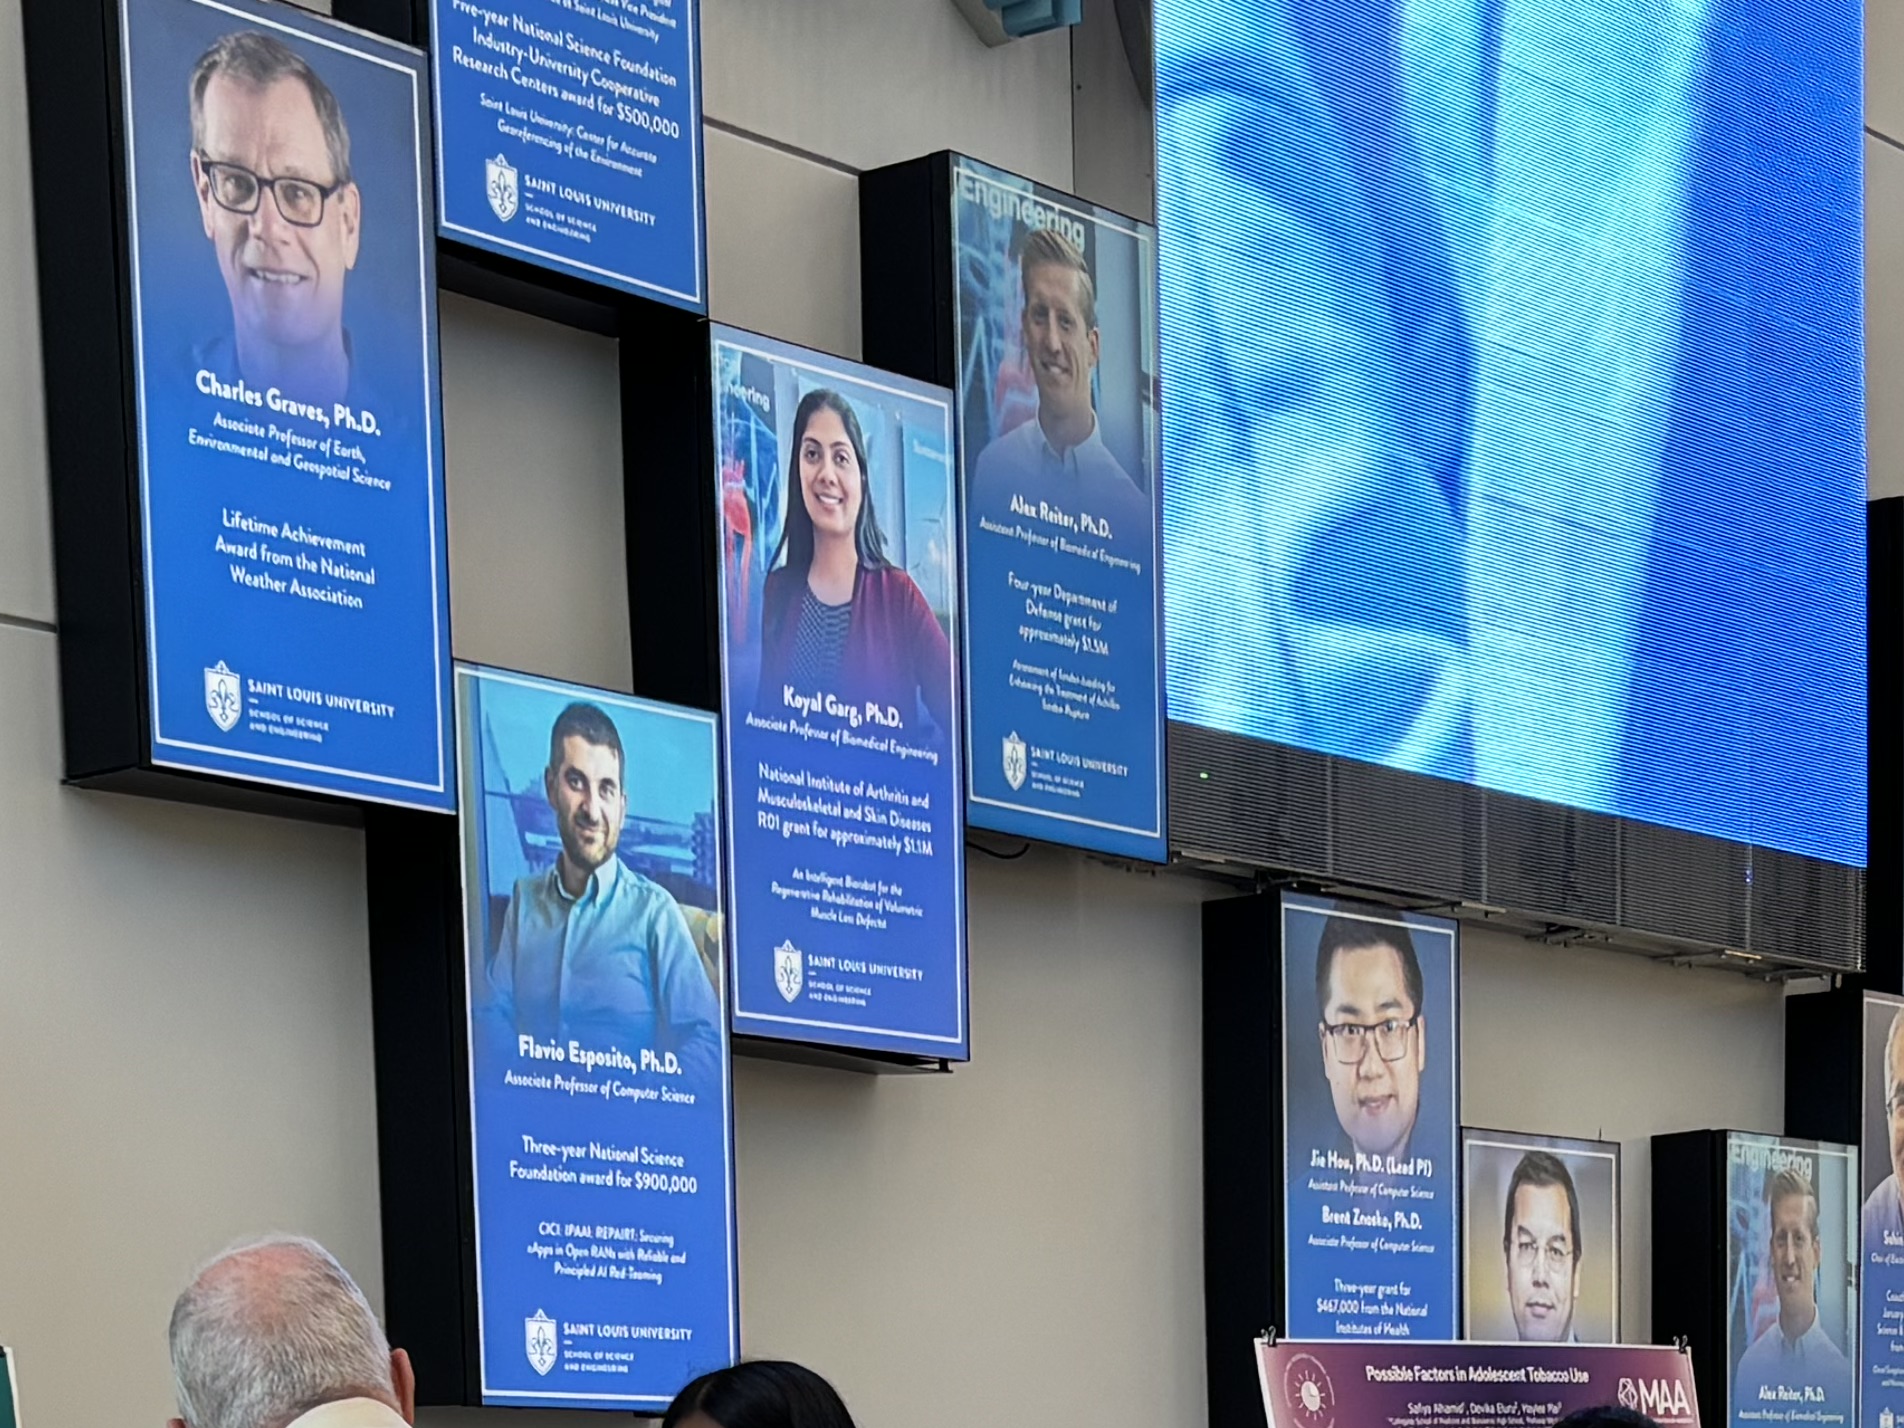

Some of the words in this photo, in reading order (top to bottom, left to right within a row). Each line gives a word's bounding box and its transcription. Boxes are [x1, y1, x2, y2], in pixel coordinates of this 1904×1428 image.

[474, 27, 588, 84] Industry-University
[591, 68, 659, 106] Cooperative
[513, 15, 563, 46] National
[566, 32, 610, 64] Science
[614, 50, 676, 86] Foundation
[453, 46, 508, 80] Research
[511, 66, 558, 97] Centers
[561, 90, 594, 110] award
[598, 96, 614, 115] for
[617, 102, 679, 138] $500,000
[525, 175, 556, 194] SAINT
[560, 186, 591, 206] LOUIS
[594, 197, 655, 225] UNIVERSITY
[196, 370, 262, 406] Charles
[266, 388, 330, 428] Graves,
[334, 404, 380, 436] Ph.D.
[214, 412, 265, 438] Associate
[268, 424, 317, 449] Professor
[320, 438, 332, 457] of
[334, 440, 366, 464] Earth,
[189, 428, 268, 460] Environmental
[270, 452, 291, 466] and
[294, 454, 350, 480] Geospatial
[352, 467, 390, 490] Science
[223, 508, 278, 537] Lifetime
[281, 523, 365, 556] Achievement
[1011, 494, 1036, 518] Alex
[1040, 501, 1078, 532] Reiter,
[1081, 513, 1112, 539] Ph.D.
[216, 535, 257, 560] Award
[261, 544, 293, 567] from
[296, 553, 317, 572] the
[321, 557, 374, 584] National
[230, 564, 286, 592] Weather
[290, 578, 362, 608] Association
[1054, 584, 1106, 611] Department
[1108, 600, 1117, 612] of
[1026, 599, 1062, 622] Defense
[1089, 616, 1101, 631] for
[1019, 626, 1080, 652] approximately
[248, 679, 282, 697] SAINT
[287, 687, 322, 705] LOUIS
[326, 694, 394, 717] UNIVERSITY
[784, 685, 821, 716] Koyal
[825, 694, 862, 725] Garg,
[866, 702, 902, 728] Ph.D.
[746, 713, 787, 732] Associate
[790, 721, 828, 740] Professor
[831, 729, 841, 746] of
[842, 730, 888, 751] Biomedical
[890, 739, 938, 766] Engineering
[759, 762, 804, 785] National
[807, 772, 850, 794] Institute
[853, 781, 864, 796] of
[866, 784, 909, 805] Arthritis
[912, 794, 929, 809] and
[758, 787, 841, 816] Musculoskeletal
[844, 805, 862, 820] and
[864, 806, 887, 824] Skin
[890, 810, 931, 832] Diseases
[813, 820, 828, 838] for
[830, 830, 901, 854] approximately
[808, 954, 835, 968] SAINT
[839, 960, 866, 973] LOUIS
[869, 964, 922, 980] UNIVERSITY
[519, 1034, 564, 1061] Flavio
[569, 1040, 636, 1074] Esposito,
[641, 1049, 682, 1074] Ph.D.
[505, 1070, 551, 1088] Associate
[554, 1074, 598, 1096] Professor
[600, 1080, 611, 1099] of
[613, 1081, 658, 1101] Computer
[662, 1086, 695, 1104] Science
[522, 1135, 586, 1162] Three-year
[590, 1142, 638, 1162] National
[641, 1147, 684, 1167] Science
[1311, 1149, 1325, 1167] Jie
[1328, 1150, 1353, 1173] Hou,
[1356, 1153, 1384, 1172] Ph.D.
[510, 1160, 576, 1182] Foundation
[580, 1170, 613, 1186] award
[616, 1170, 632, 1187] for
[635, 1171, 697, 1194] $900,000
[1322, 1205, 1350, 1224] Brent
[1394, 1211, 1422, 1229] Ph.D.
[1334, 1278, 1376, 1297] Three-year
[1400, 1282, 1411, 1296] for
[1361, 1301, 1379, 1314] from
[1381, 1302, 1394, 1315] the
[1396, 1303, 1428, 1316] National
[564, 1322, 594, 1336] SAINT
[598, 1325, 628, 1338] LOUIS
[631, 1327, 692, 1340] UNIVERSITY
[1336, 1320, 1372, 1334] Institutes
[1374, 1322, 1382, 1334] of
[1384, 1323, 1410, 1336] Health
[1366, 1365, 1413, 1381] Possible
[1414, 1365, 1455, 1381] Factors
[1455, 1366, 1467, 1381] in
[1469, 1367, 1526, 1382] Adolescent
[1527, 1368, 1569, 1382] Tobacco
[1570, 1369, 1589, 1382] Use
[1639, 1378, 1691, 1415] MAA
